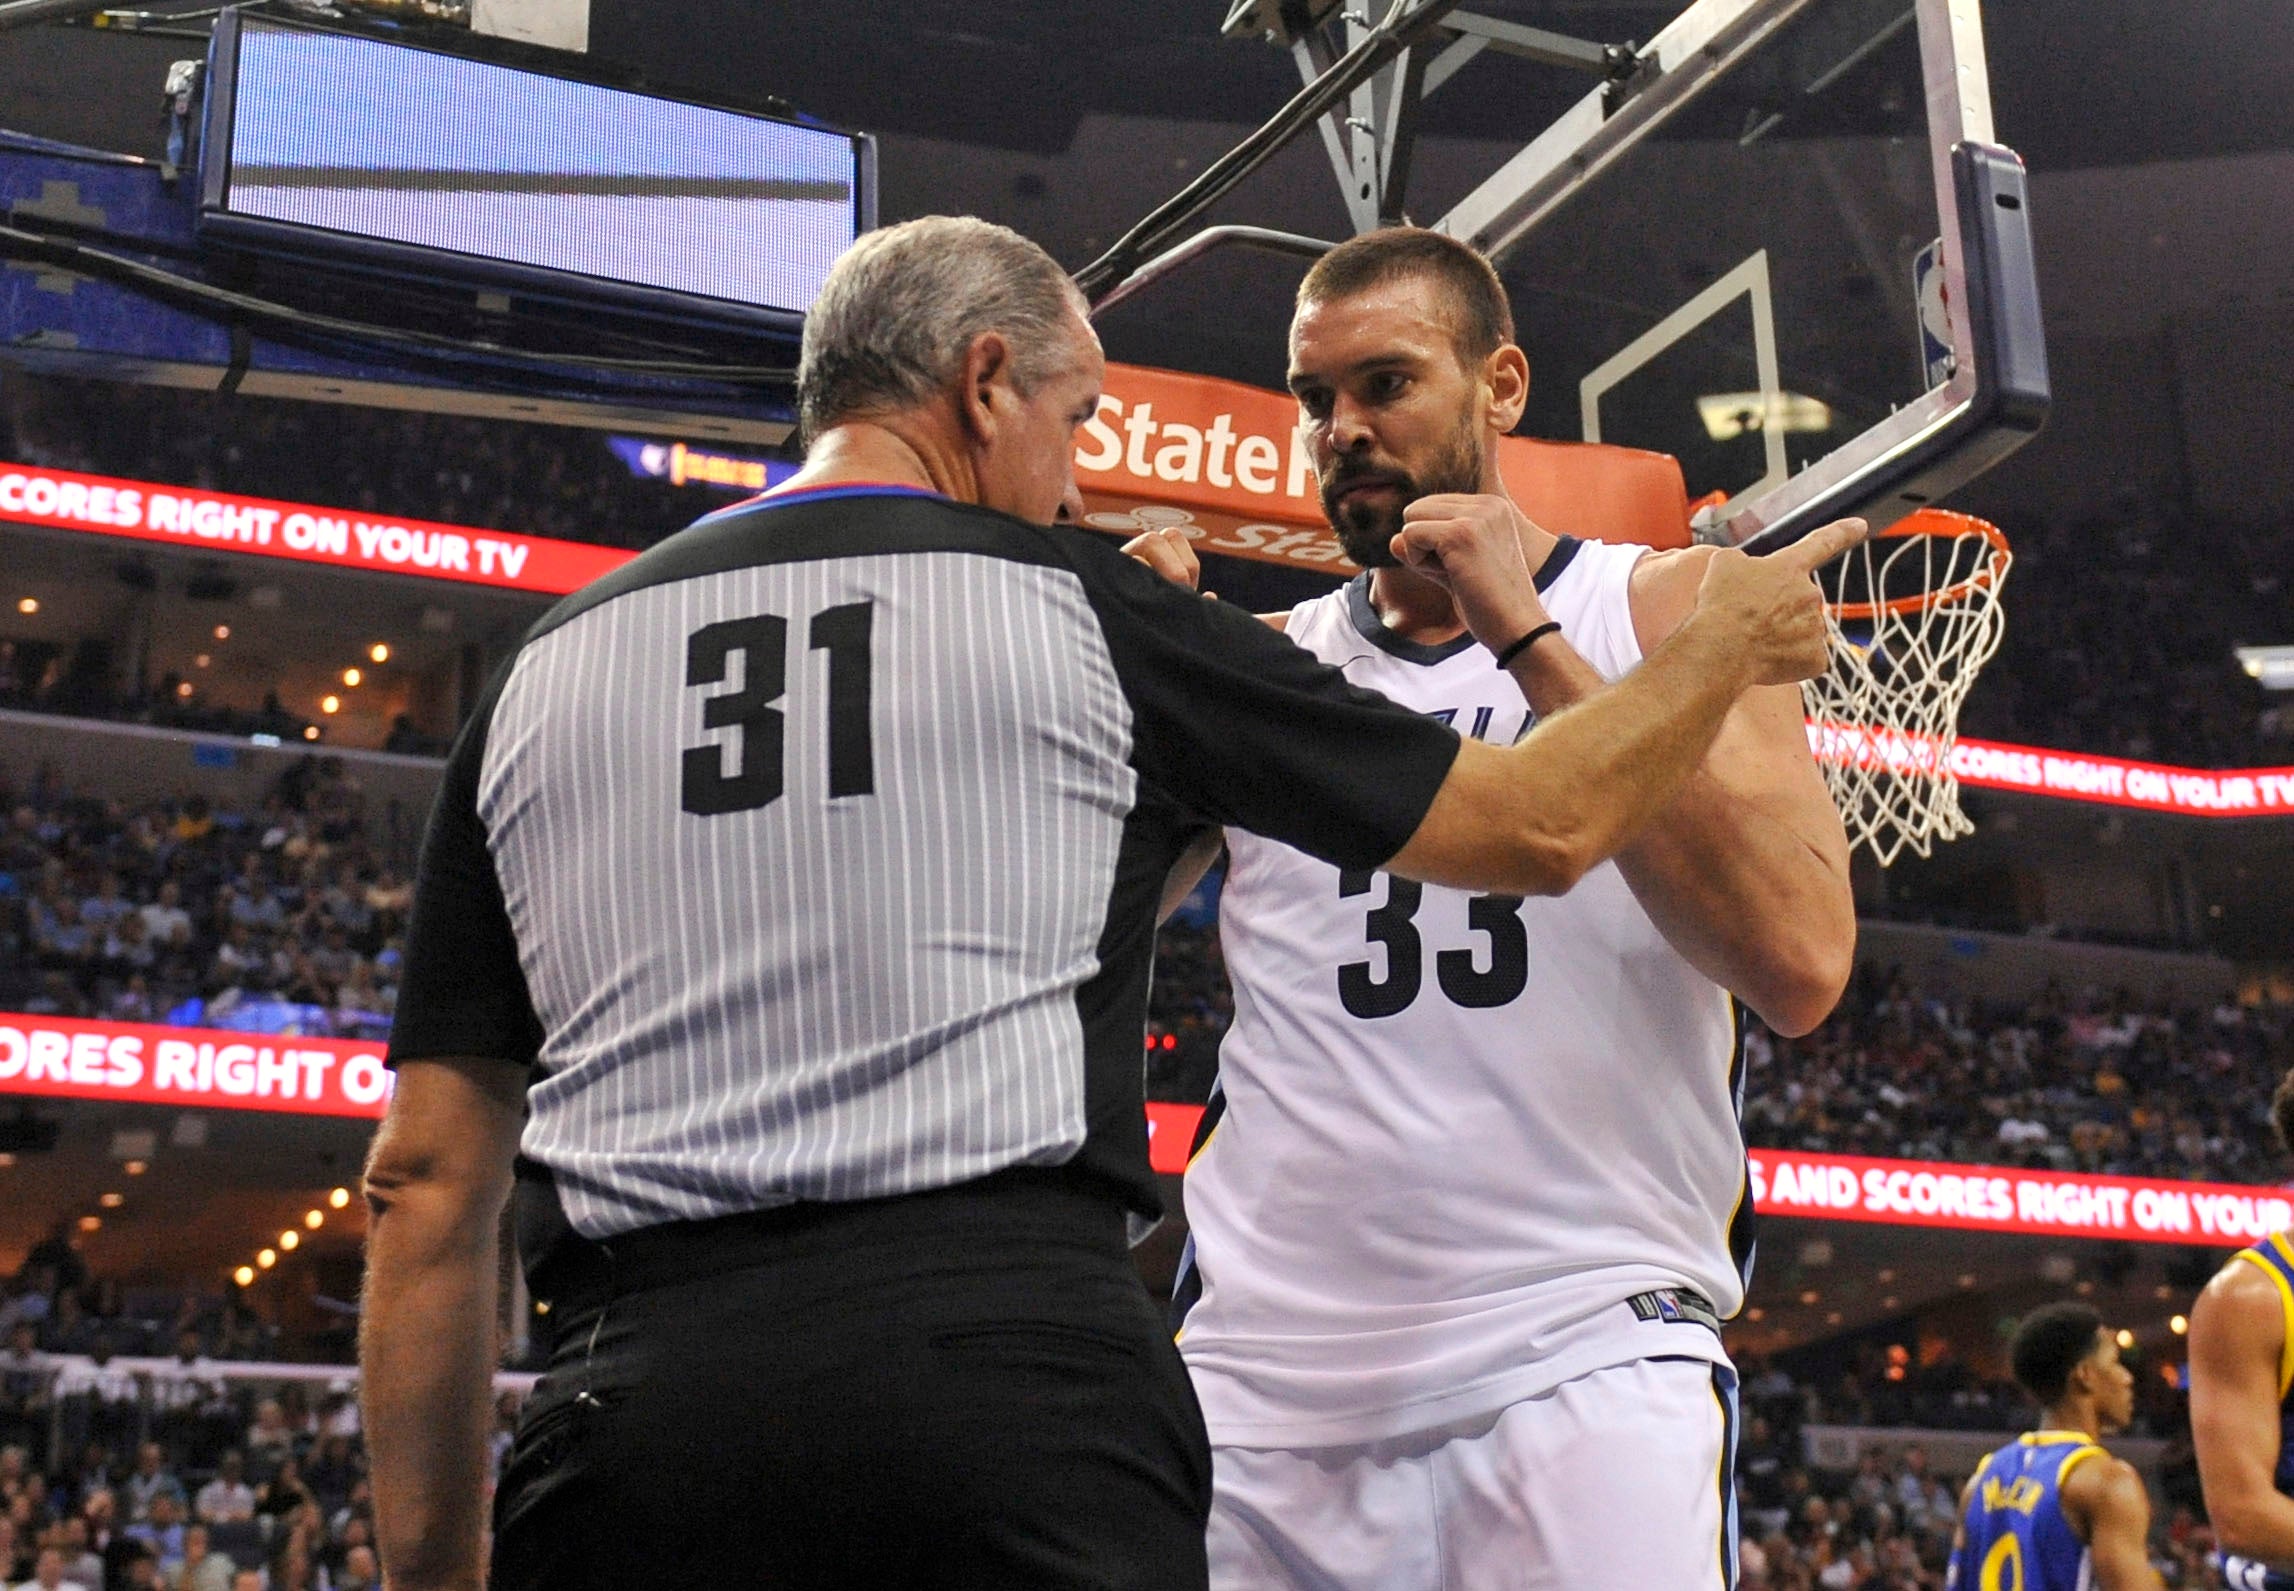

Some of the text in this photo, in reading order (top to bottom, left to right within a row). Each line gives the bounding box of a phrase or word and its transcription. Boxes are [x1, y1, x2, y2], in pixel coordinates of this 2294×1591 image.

[1075, 393, 1279, 495] State
[0, 473, 529, 578] CORES RIGHT ON YOUR TV
[1210, 523, 1357, 567] Sta
[682, 601, 875, 816] 31
[1938, 743, 2041, 786] CORES
[2043, 756, 2124, 797] RIGHT
[2126, 768, 2169, 804] ON
[2169, 774, 2256, 809] YOUR
[1338, 865, 1528, 1019] 33
[154, 1039, 336, 1101] RIGHT
[341, 1053, 396, 1105] O
[1770, 1162, 1860, 1209] AND
[1862, 1168, 2014, 1222] SCORES
[2016, 1179, 2131, 1229] RIGHT
[2132, 1187, 2192, 1233] ON
[2191, 1192, 2292, 1238] YOUR
